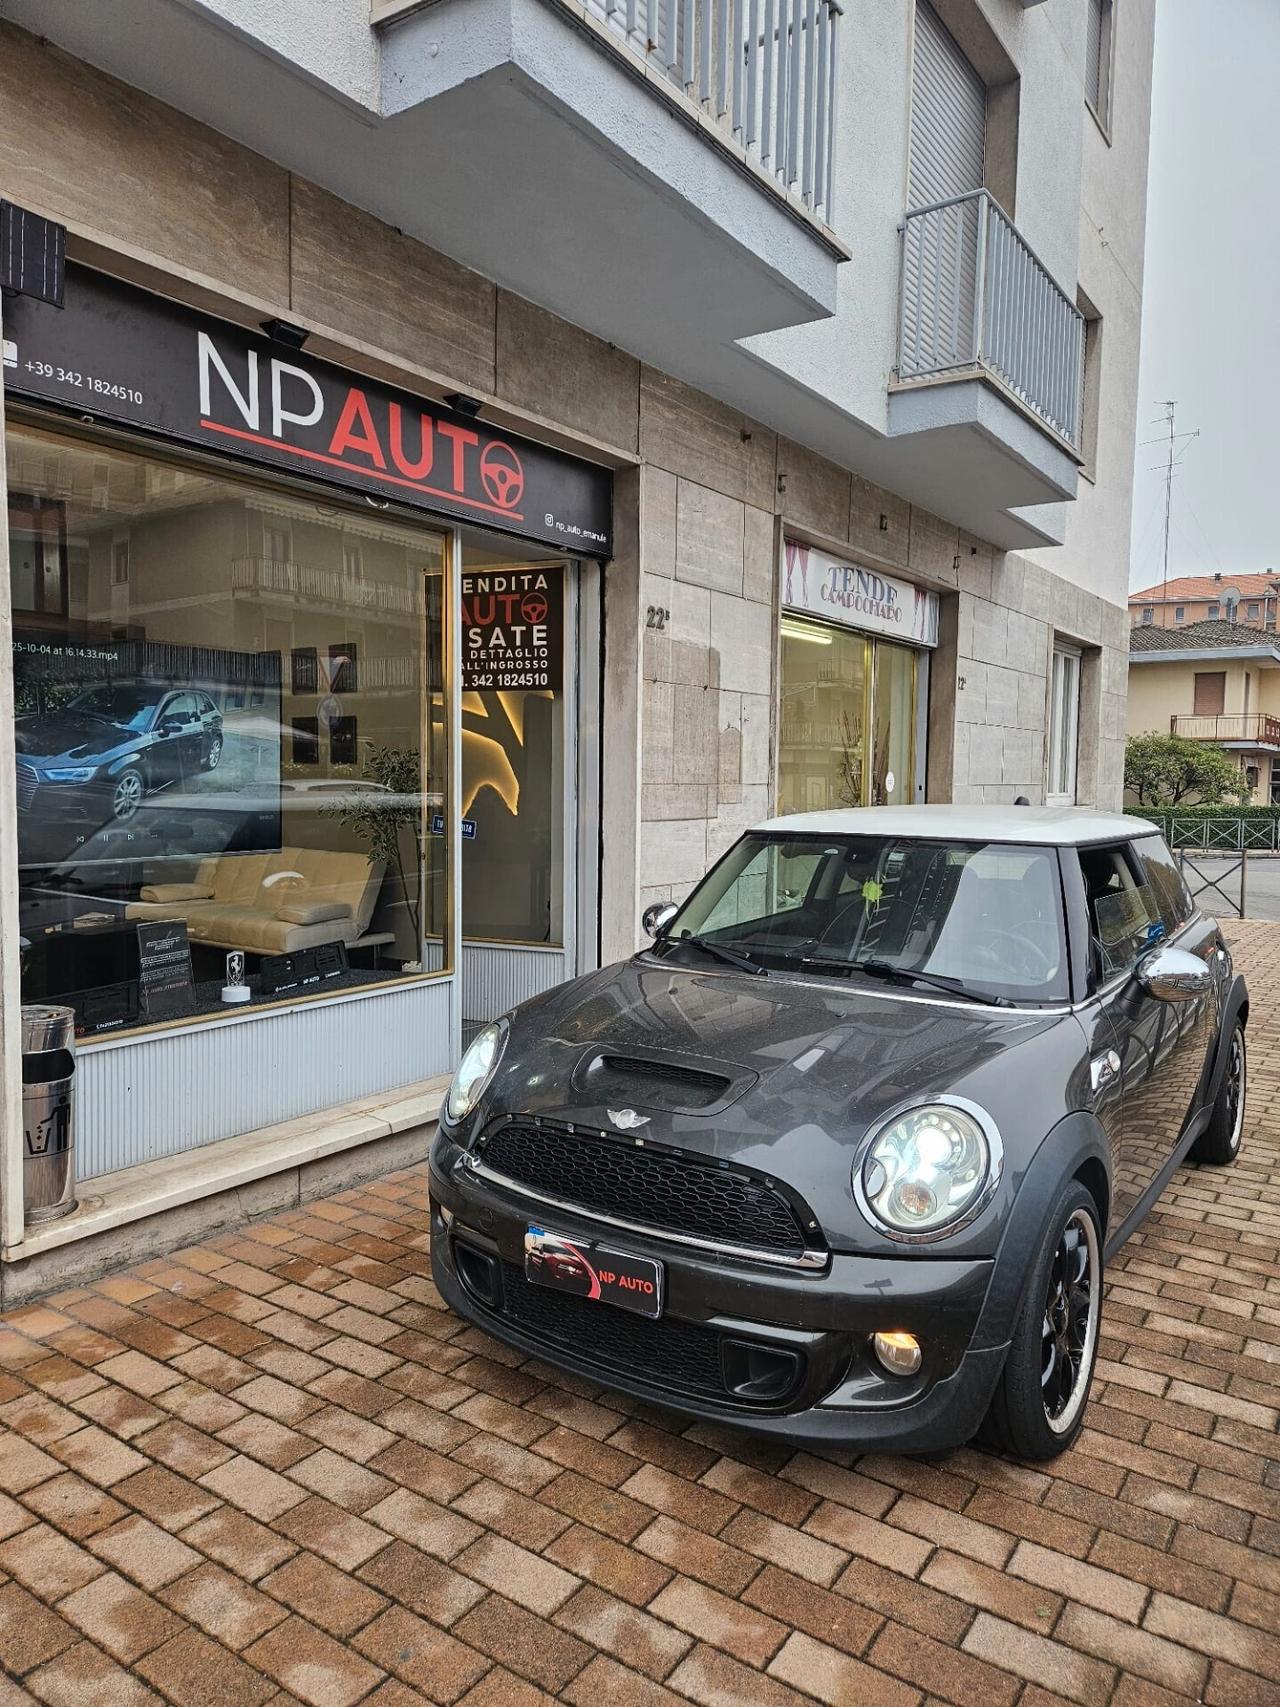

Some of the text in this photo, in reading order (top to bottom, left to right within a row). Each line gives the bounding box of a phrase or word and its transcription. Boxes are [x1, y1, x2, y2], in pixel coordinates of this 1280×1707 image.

[25, 361, 143, 404] +39 342 1824510
[462, 574, 548, 594] ENDITA
[468, 625, 548, 648] SATE
[53, 647, 62, 655] at
[470, 648, 548, 659] DETTAGLIO
[472, 674, 493, 687] 342
[497, 673, 548, 686] 1824510
[599, 1270, 654, 1294] NP AUTO
